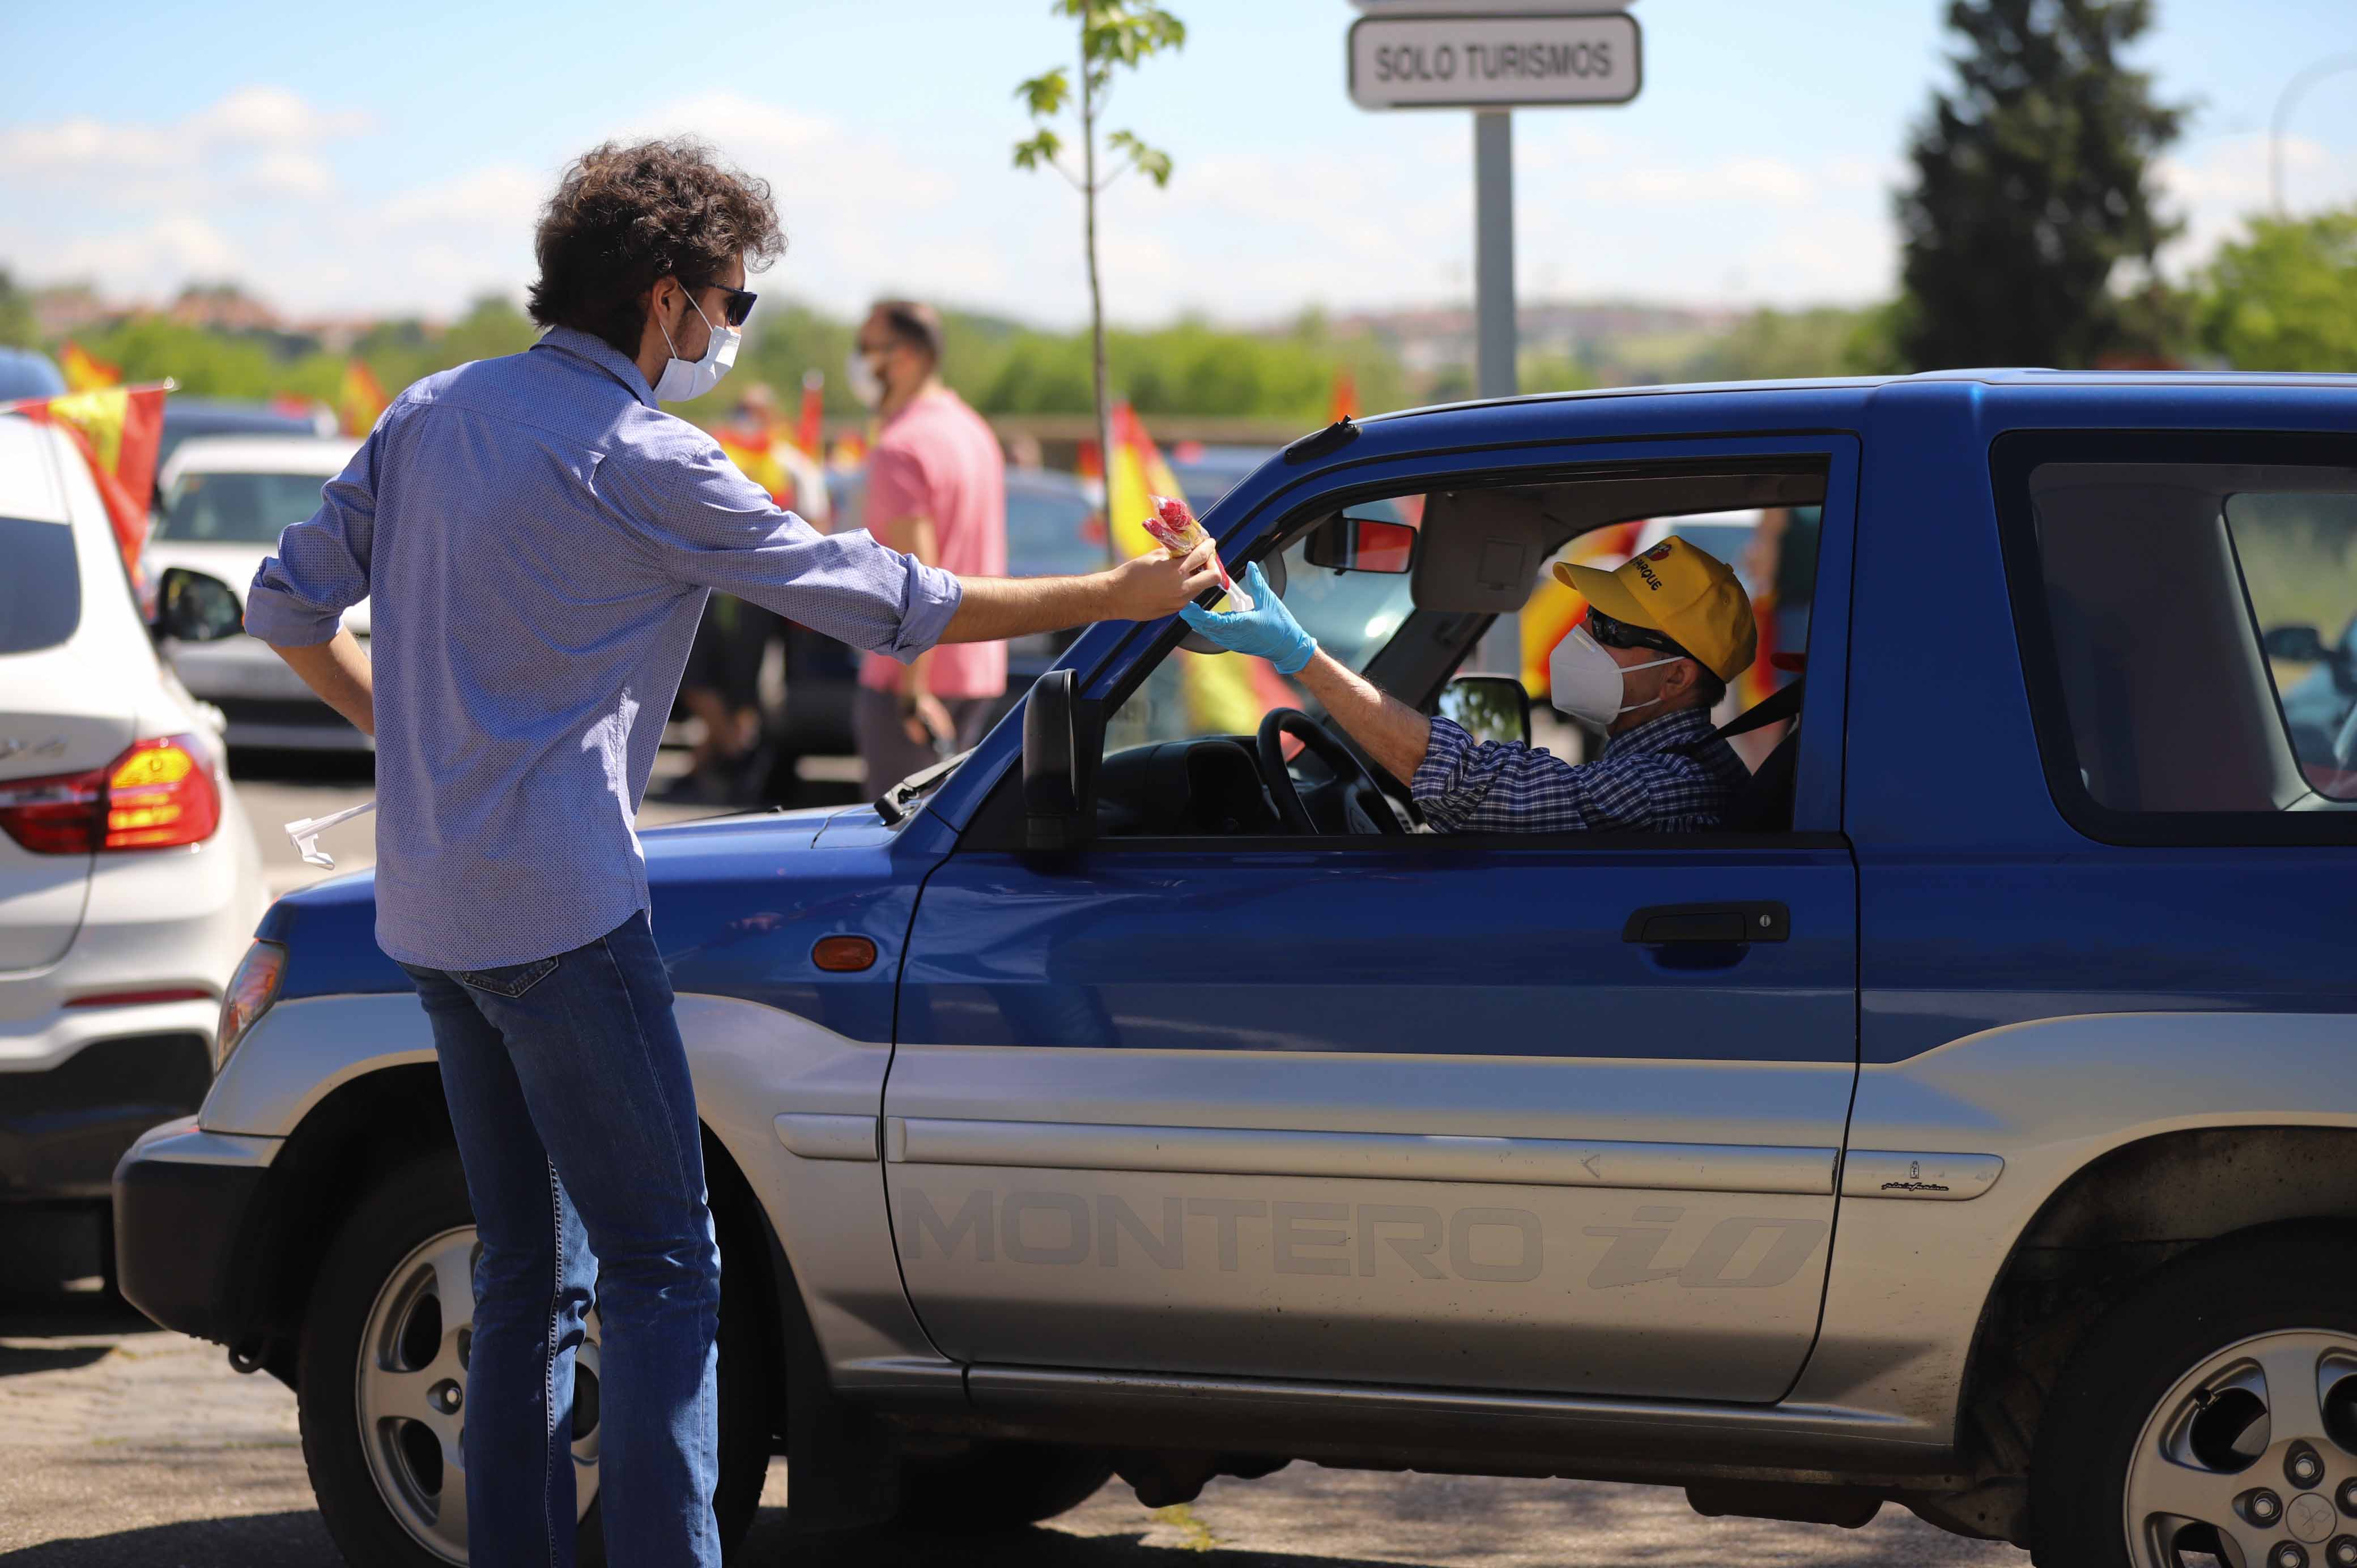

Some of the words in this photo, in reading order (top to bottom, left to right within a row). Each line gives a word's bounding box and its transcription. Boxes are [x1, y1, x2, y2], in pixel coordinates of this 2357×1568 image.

[1375, 44, 1457, 82] SOLO
[1465, 41, 1613, 80] TURISMOS
[899, 1187, 1543, 1282] MONTERO
